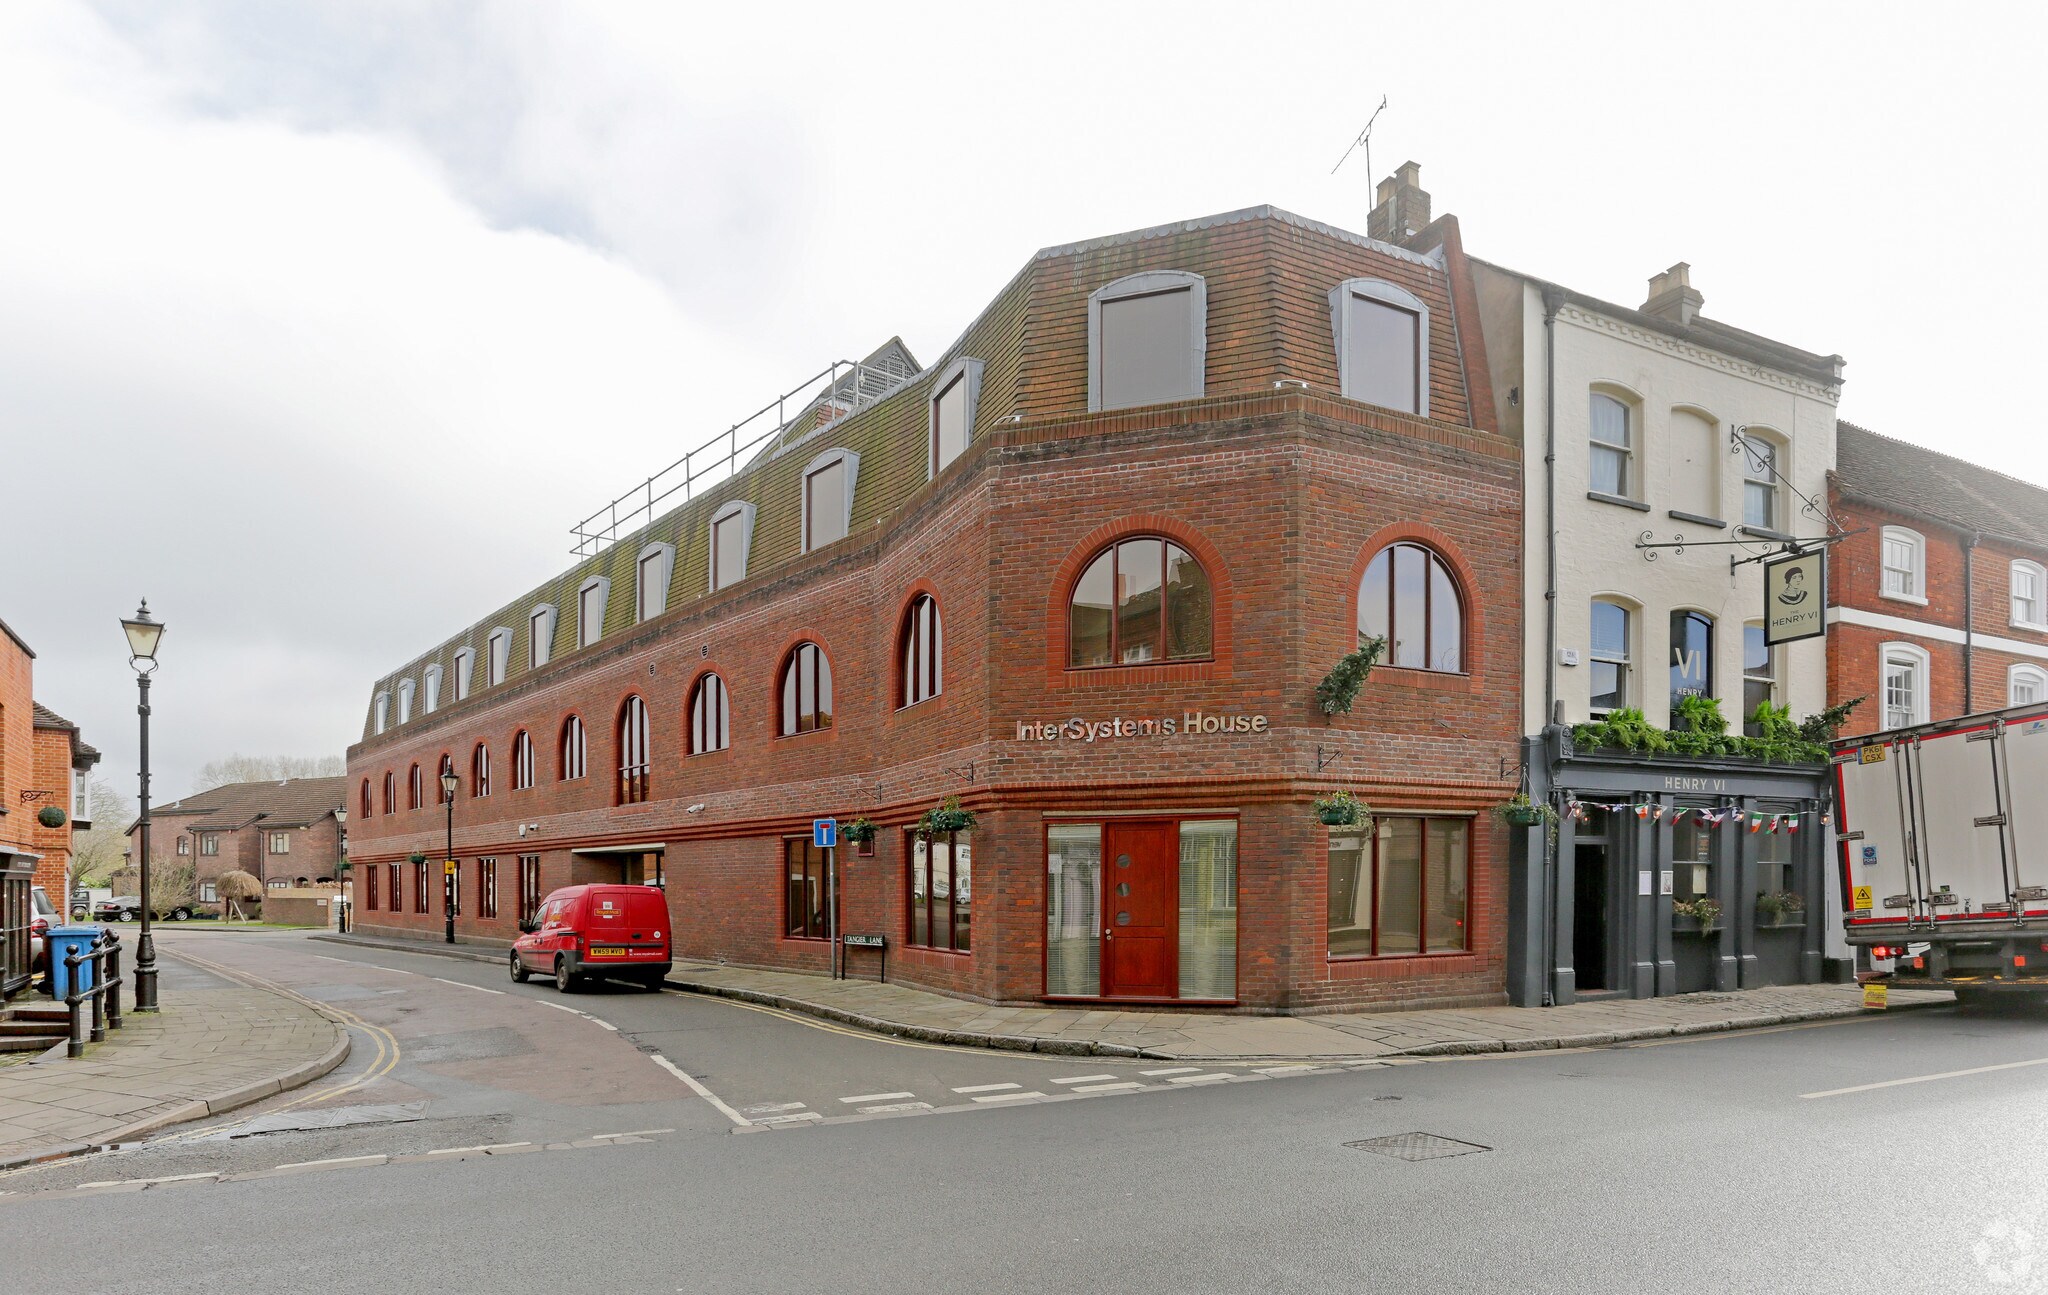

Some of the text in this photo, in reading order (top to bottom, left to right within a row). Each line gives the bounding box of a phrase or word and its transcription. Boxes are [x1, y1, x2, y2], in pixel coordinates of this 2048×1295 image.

[1772, 613, 1806, 627] HENRY
[1808, 611, 1818, 619] VI
[1675, 647, 1701, 680] VI
[1677, 687, 1703, 697] HENRY
[1016, 712, 1268, 743] InterSystems House
[1863, 745, 1882, 754] PK61
[1865, 754, 1882, 762] CSX
[1665, 776, 1725, 791] HENRY VI
[847, 935, 883, 944] TANGIER LANE
